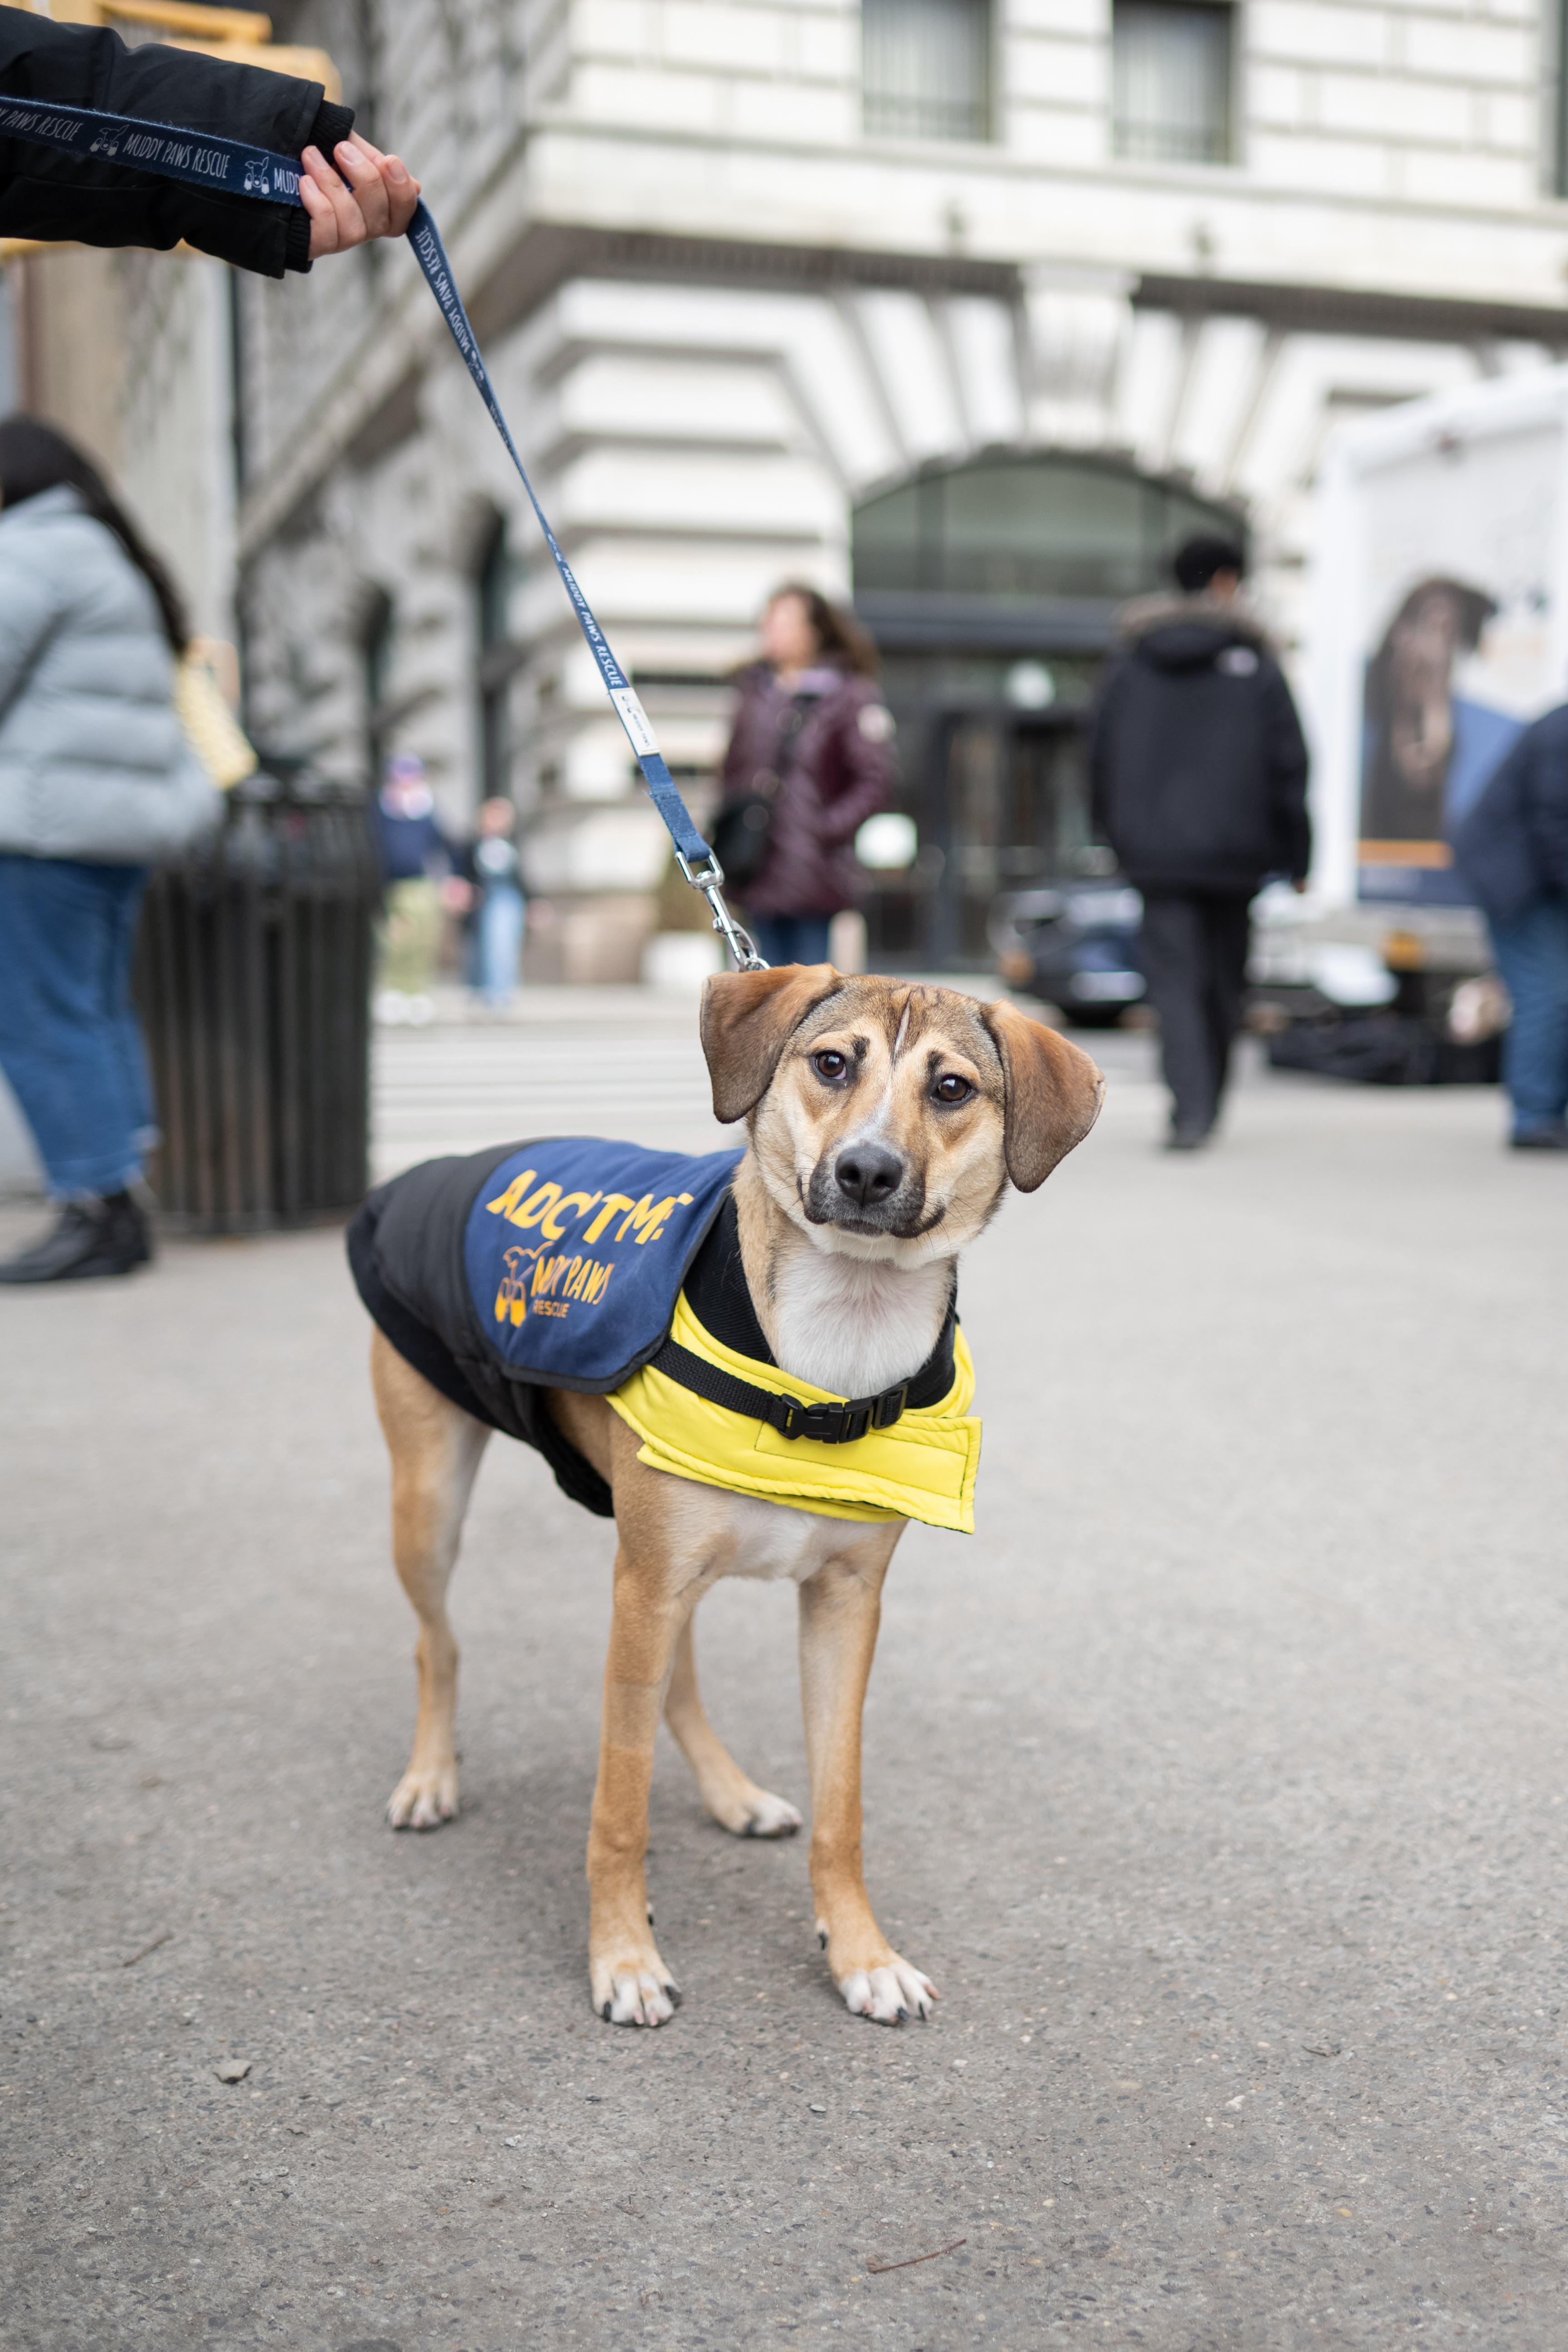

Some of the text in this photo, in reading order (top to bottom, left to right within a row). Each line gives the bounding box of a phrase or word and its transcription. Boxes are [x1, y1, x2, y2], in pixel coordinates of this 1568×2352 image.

[2, 110, 42, 131] PAWS
[35, 116, 84, 141] RESCUE
[123, 133, 230, 179] MUDDY PAWS RESCUE
[274, 167, 300, 195] MUDD
[415, 225, 471, 354] MUDDY PAWS RESCUE
[581, 611, 603, 643] PAWS
[595, 644, 623, 686] RESCUE
[562, 1255, 615, 1305] PAWS
